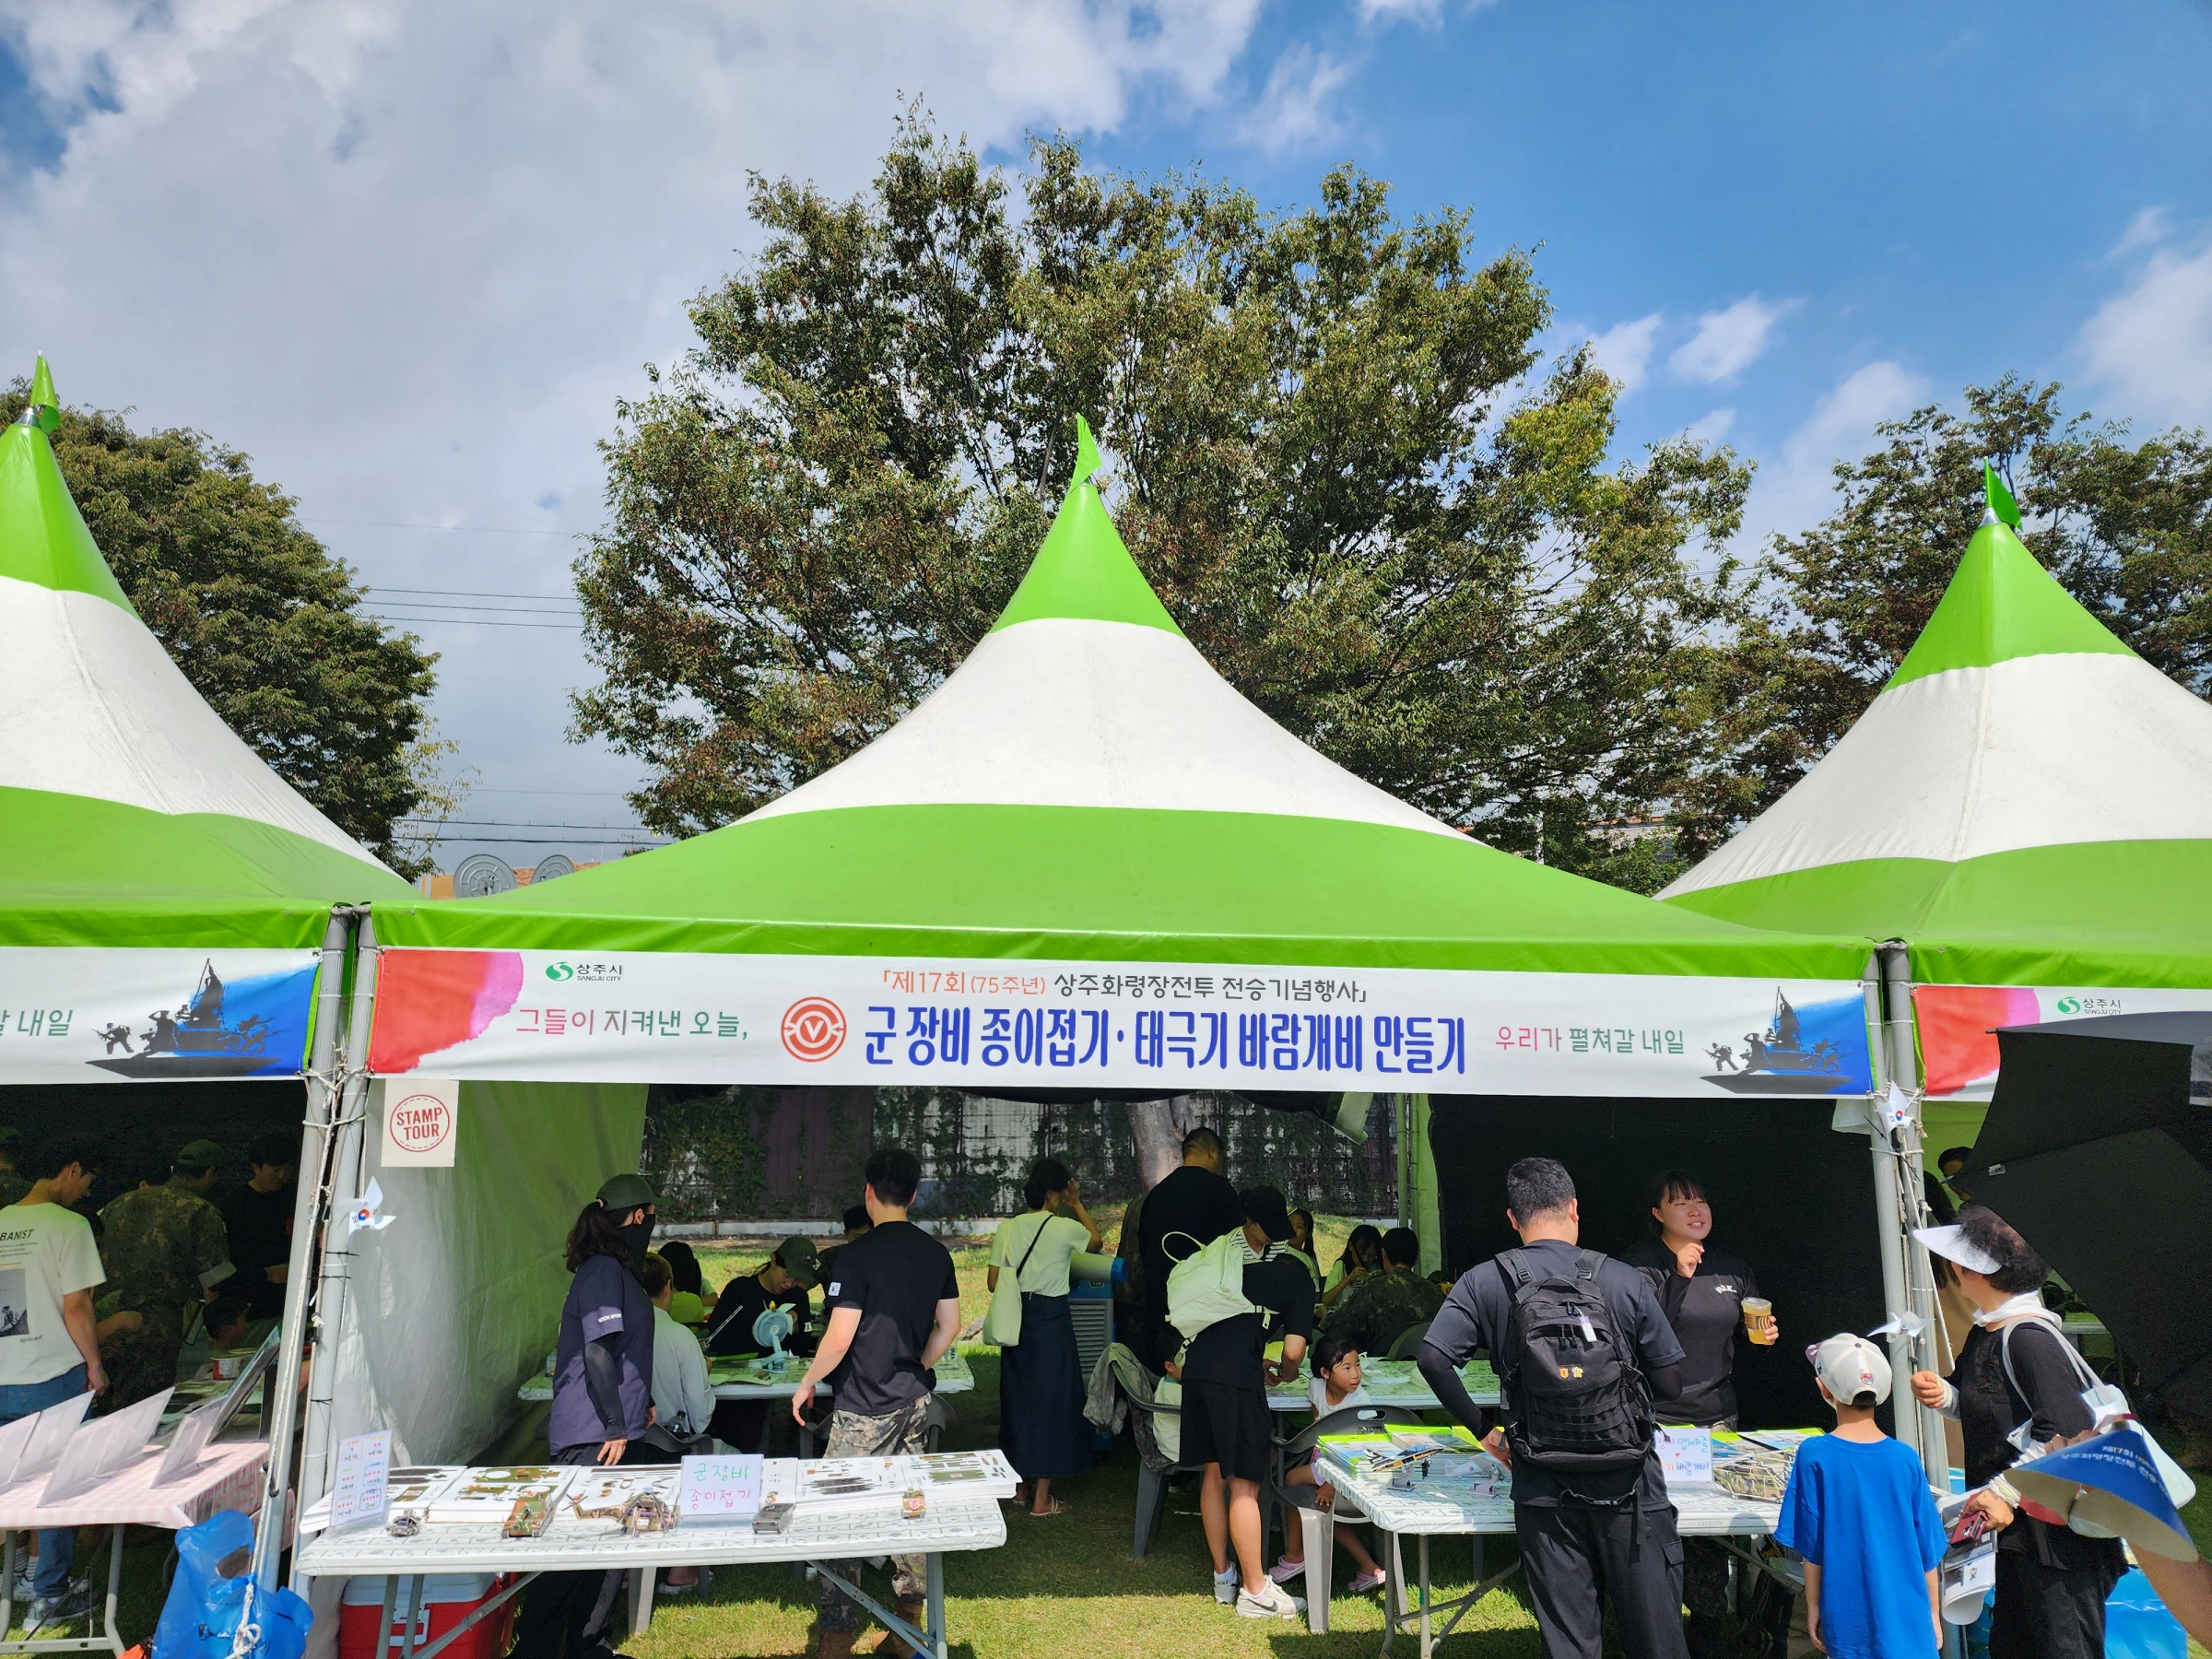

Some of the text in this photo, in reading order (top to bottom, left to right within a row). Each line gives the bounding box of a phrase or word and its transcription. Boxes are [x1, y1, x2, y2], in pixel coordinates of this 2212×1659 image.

[576, 962, 623, 976] 상주시
[1053, 973, 1216, 999] 상주화령장전투
[2082, 997, 2122, 1009] 상주시
[18, 1009, 73, 1037] 내일
[516, 1008, 748, 1040] 그들이 지켜낸 오늘,
[1239, 1013, 1363, 1073] 바람개비
[1373, 1016, 1465, 1076] 만들기
[1495, 1026, 1685, 1054] 우리가 펼쳐갈 내일
[396, 1107, 442, 1126] STAMP
[403, 1123, 440, 1141] TOUR
[694, 1463, 749, 1482] 군장비
[1677, 1461, 1709, 1477] 바람개비
[688, 1488, 751, 1511] 종이접기
